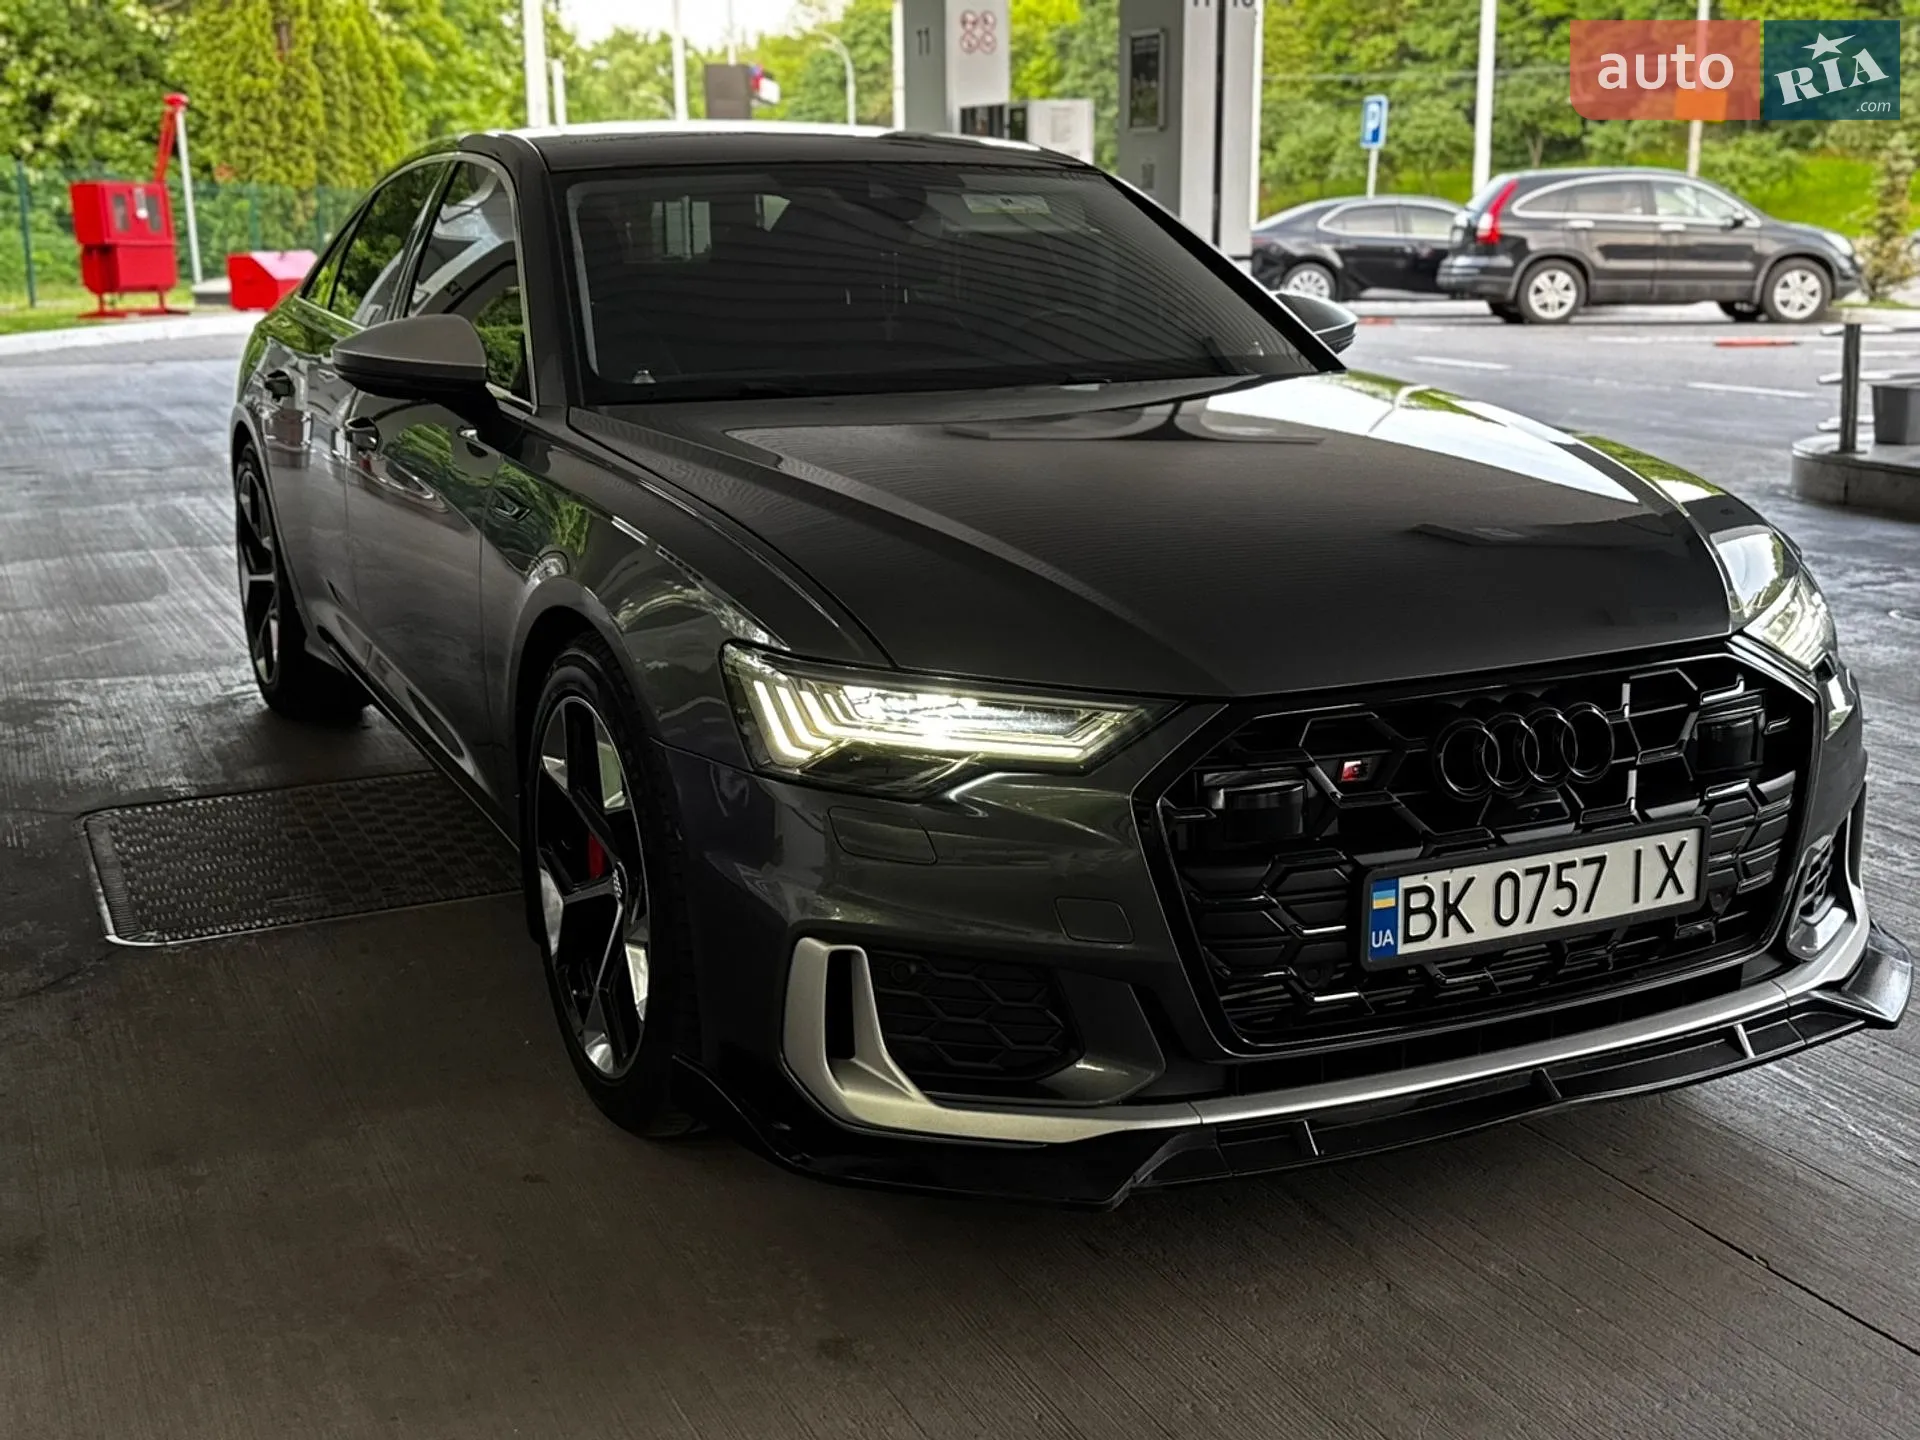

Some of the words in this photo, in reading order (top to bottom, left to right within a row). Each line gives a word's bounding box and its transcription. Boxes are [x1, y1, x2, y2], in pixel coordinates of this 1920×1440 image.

[916, 27, 930, 56] 11
[1402, 877, 1475, 944] BK
[1494, 854, 1608, 927] 0757
[1633, 839, 1688, 904] IX
[1371, 929, 1394, 948] UA
